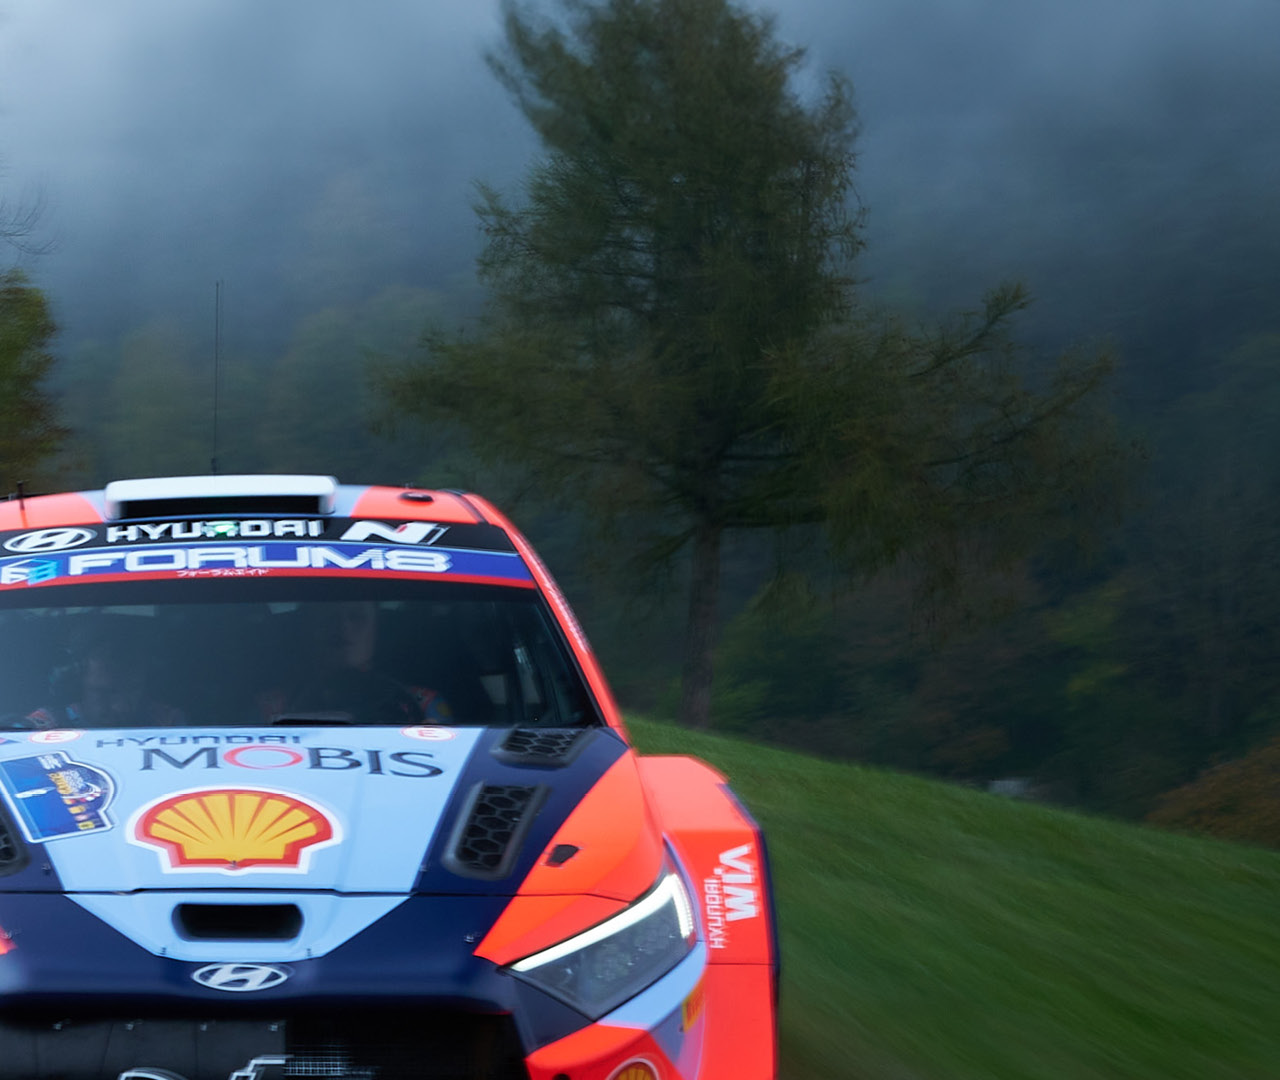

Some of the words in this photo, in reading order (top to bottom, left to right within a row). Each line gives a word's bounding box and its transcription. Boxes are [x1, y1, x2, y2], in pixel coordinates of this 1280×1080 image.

[107, 519, 324, 543] HYUNDAI
[69, 546, 452, 576] FORUM8
[96, 735, 302, 748] HYUNDAI
[140, 745, 444, 778] MOBIS
[704, 879, 727, 949] HYUNDAI
